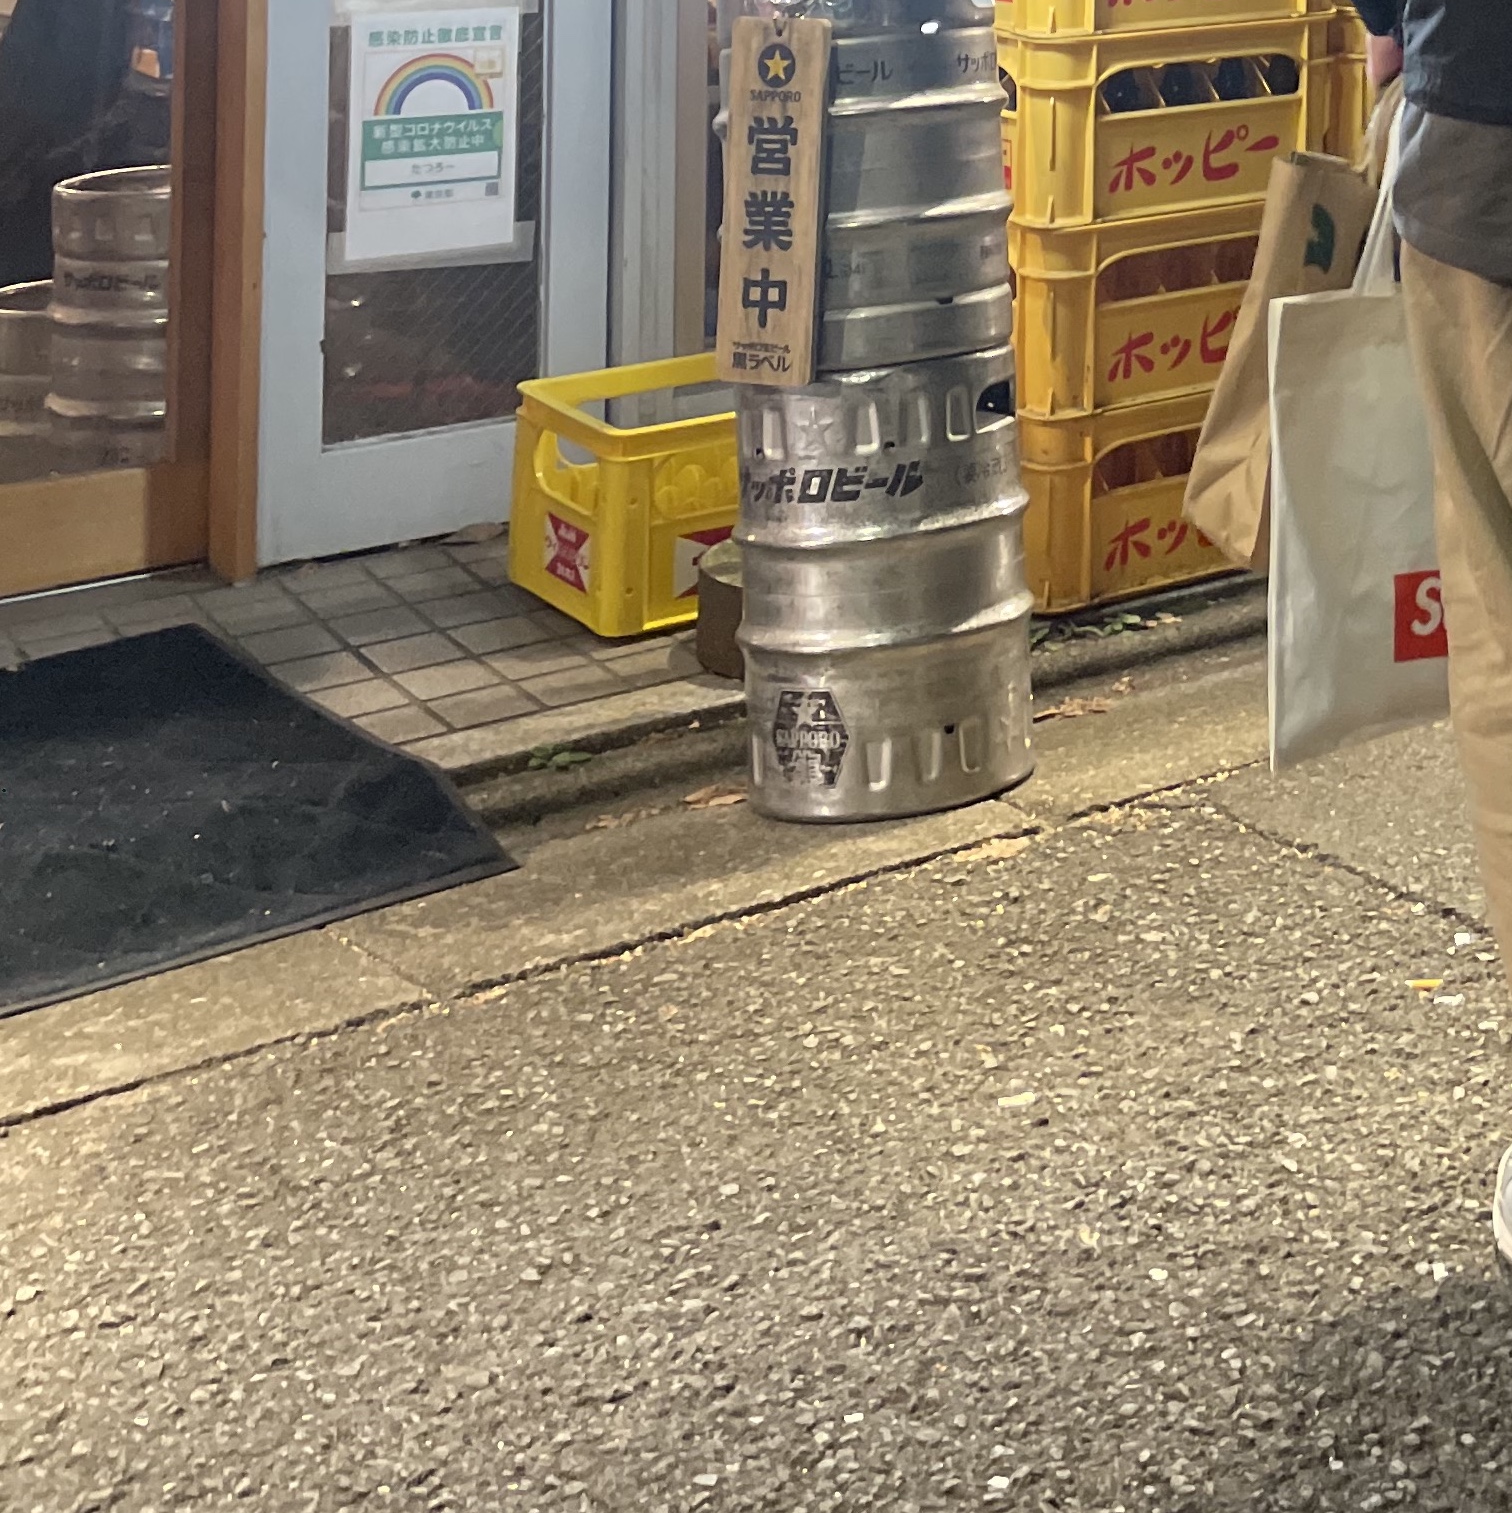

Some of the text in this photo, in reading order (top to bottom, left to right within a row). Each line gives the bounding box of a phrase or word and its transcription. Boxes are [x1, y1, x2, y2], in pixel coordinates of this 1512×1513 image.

[750, 89, 802, 103] SAPPORO
[1108, 124, 1279, 193] ホッピー
[741, 115, 798, 329] 営業中
[732, 352, 793, 372] 黒ラベル
